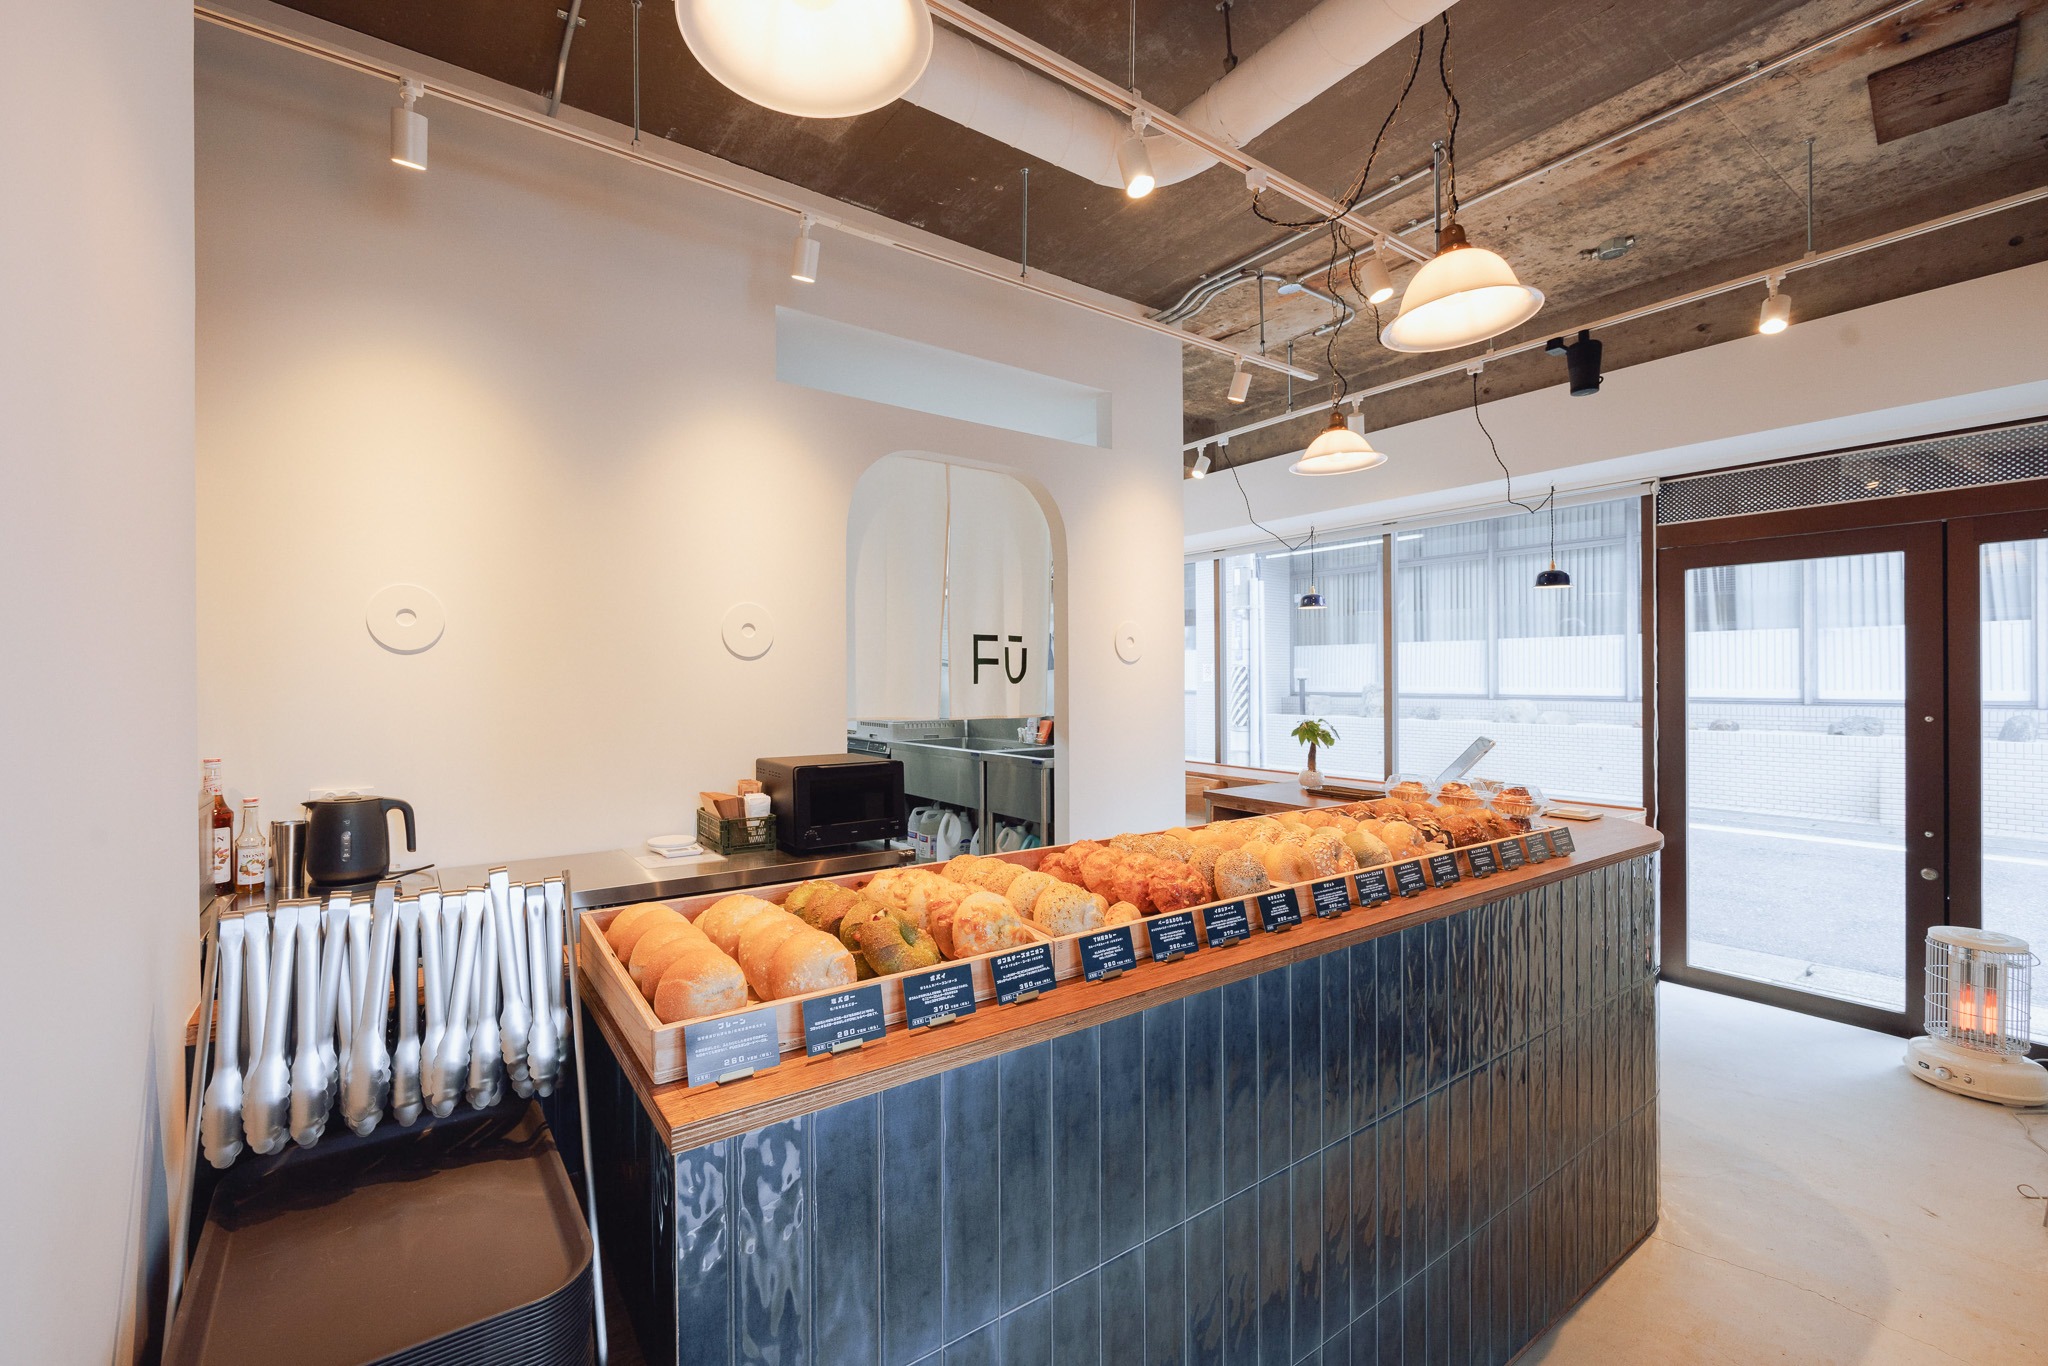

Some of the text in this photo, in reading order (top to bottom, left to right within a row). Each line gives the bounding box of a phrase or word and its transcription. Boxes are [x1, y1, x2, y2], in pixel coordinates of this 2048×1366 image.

[933, 1003, 950, 1013] 370
[718, 1018, 746, 1030] プレーン
[724, 1055, 745, 1066] 260
